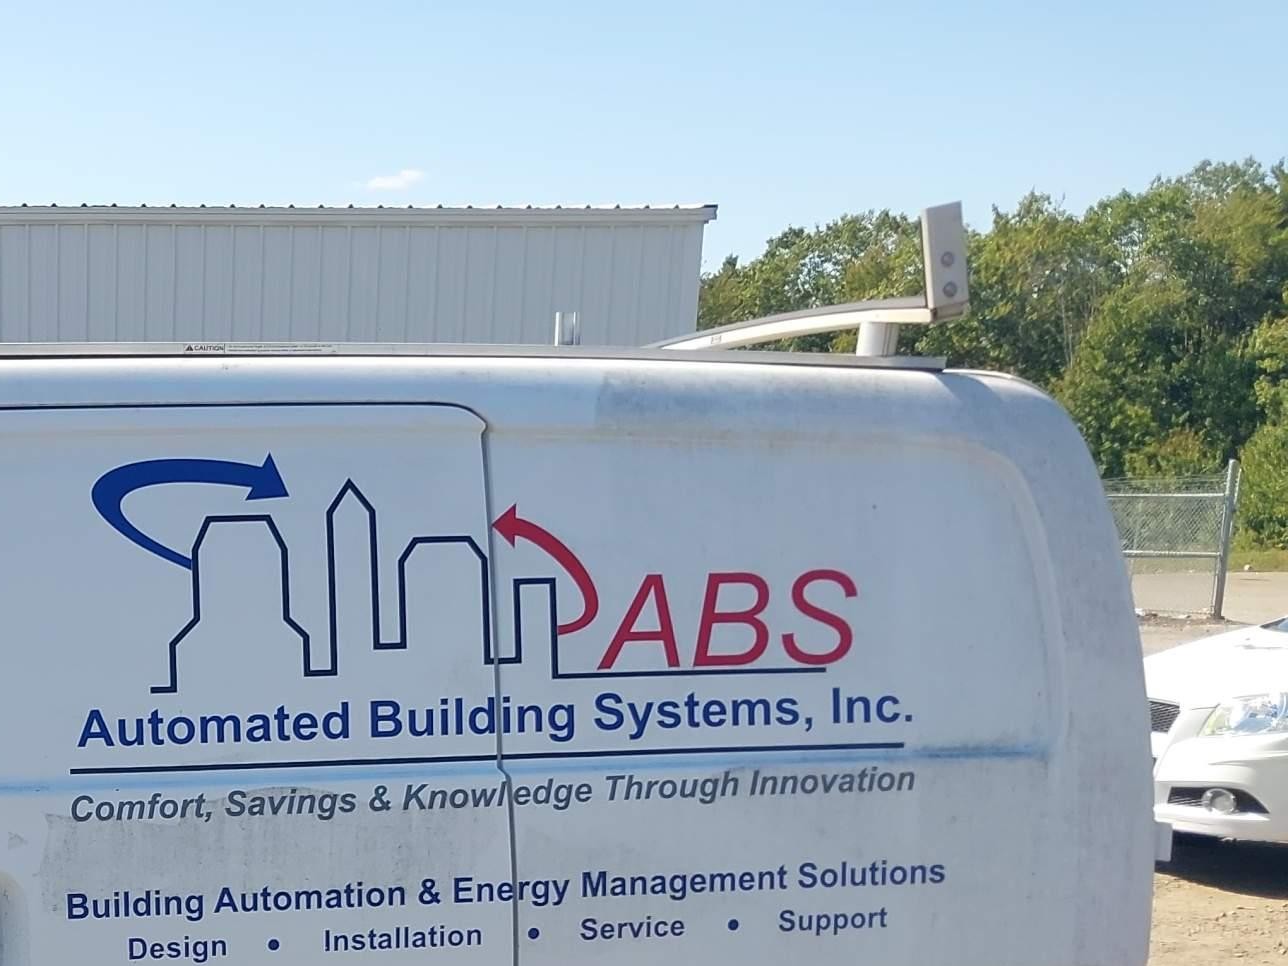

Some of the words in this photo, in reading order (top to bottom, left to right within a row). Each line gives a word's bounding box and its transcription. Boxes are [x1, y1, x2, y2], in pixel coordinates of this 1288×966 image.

[597, 570, 857, 670] ABS
[78, 704, 349, 747] Automated
[371, 696, 574, 742] Building
[594, 693, 812, 733] Systems,
[833, 688, 912, 723] Inc.
[72, 789, 212, 822] Comfort,
[225, 788, 356, 820] Savings
[369, 786, 391, 811] &
[403, 778, 592, 811] Knowledge
[606, 770, 739, 804] Through
[750, 767, 914, 796] Innovation
[67, 890, 203, 921] Building
[214, 882, 405, 913] Automation
[419, 879, 440, 904] &
[454, 877, 569, 906] Energy
[583, 866, 787, 900] Management
[798, 860, 945, 888] Solutions
[129, 936, 226, 963] Design
[325, 925, 481, 951] Installation
[581, 916, 684, 940] Service
[779, 908, 887, 936] Support
